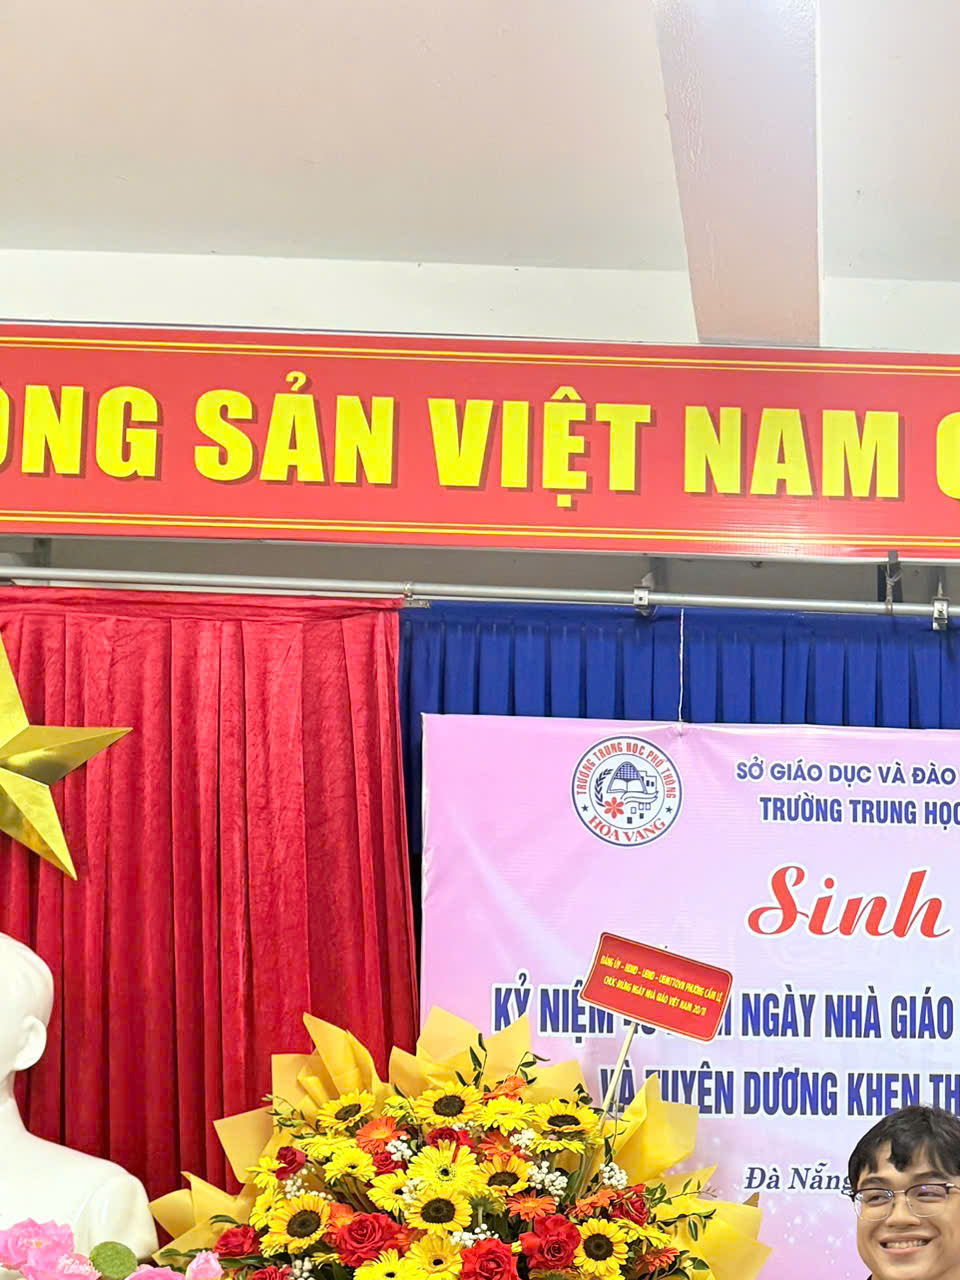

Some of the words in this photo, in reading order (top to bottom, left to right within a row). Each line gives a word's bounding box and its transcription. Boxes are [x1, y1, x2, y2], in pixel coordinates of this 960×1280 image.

[0, 384, 159, 478] NG
[194, 370, 395, 485] SẢN
[428, 384, 651, 508] VIỆT
[684, 405, 900, 499] NAM
[736, 756, 764, 781] SỞ
[770, 759, 823, 782] GIÁO
[829, 764, 872, 788] DỤC
[877, 761, 906, 784] VÀ
[911, 762, 957, 786] ĐÀO
[759, 792, 843, 823] TRƯỜNG
[849, 799, 917, 824] TRUNG
[747, 865, 950, 938] Sinh
[495, 972, 531, 1032] KỶ
[742, 984, 815, 1038] NGÀY
[824, 985, 881, 1039] NHÀ
[890, 986, 954, 1040] GIÁO
[744, 1067, 839, 1116] DƯƠNG
[847, 1072, 921, 1117] KHEN
[744, 1166, 781, 1190] Đà
